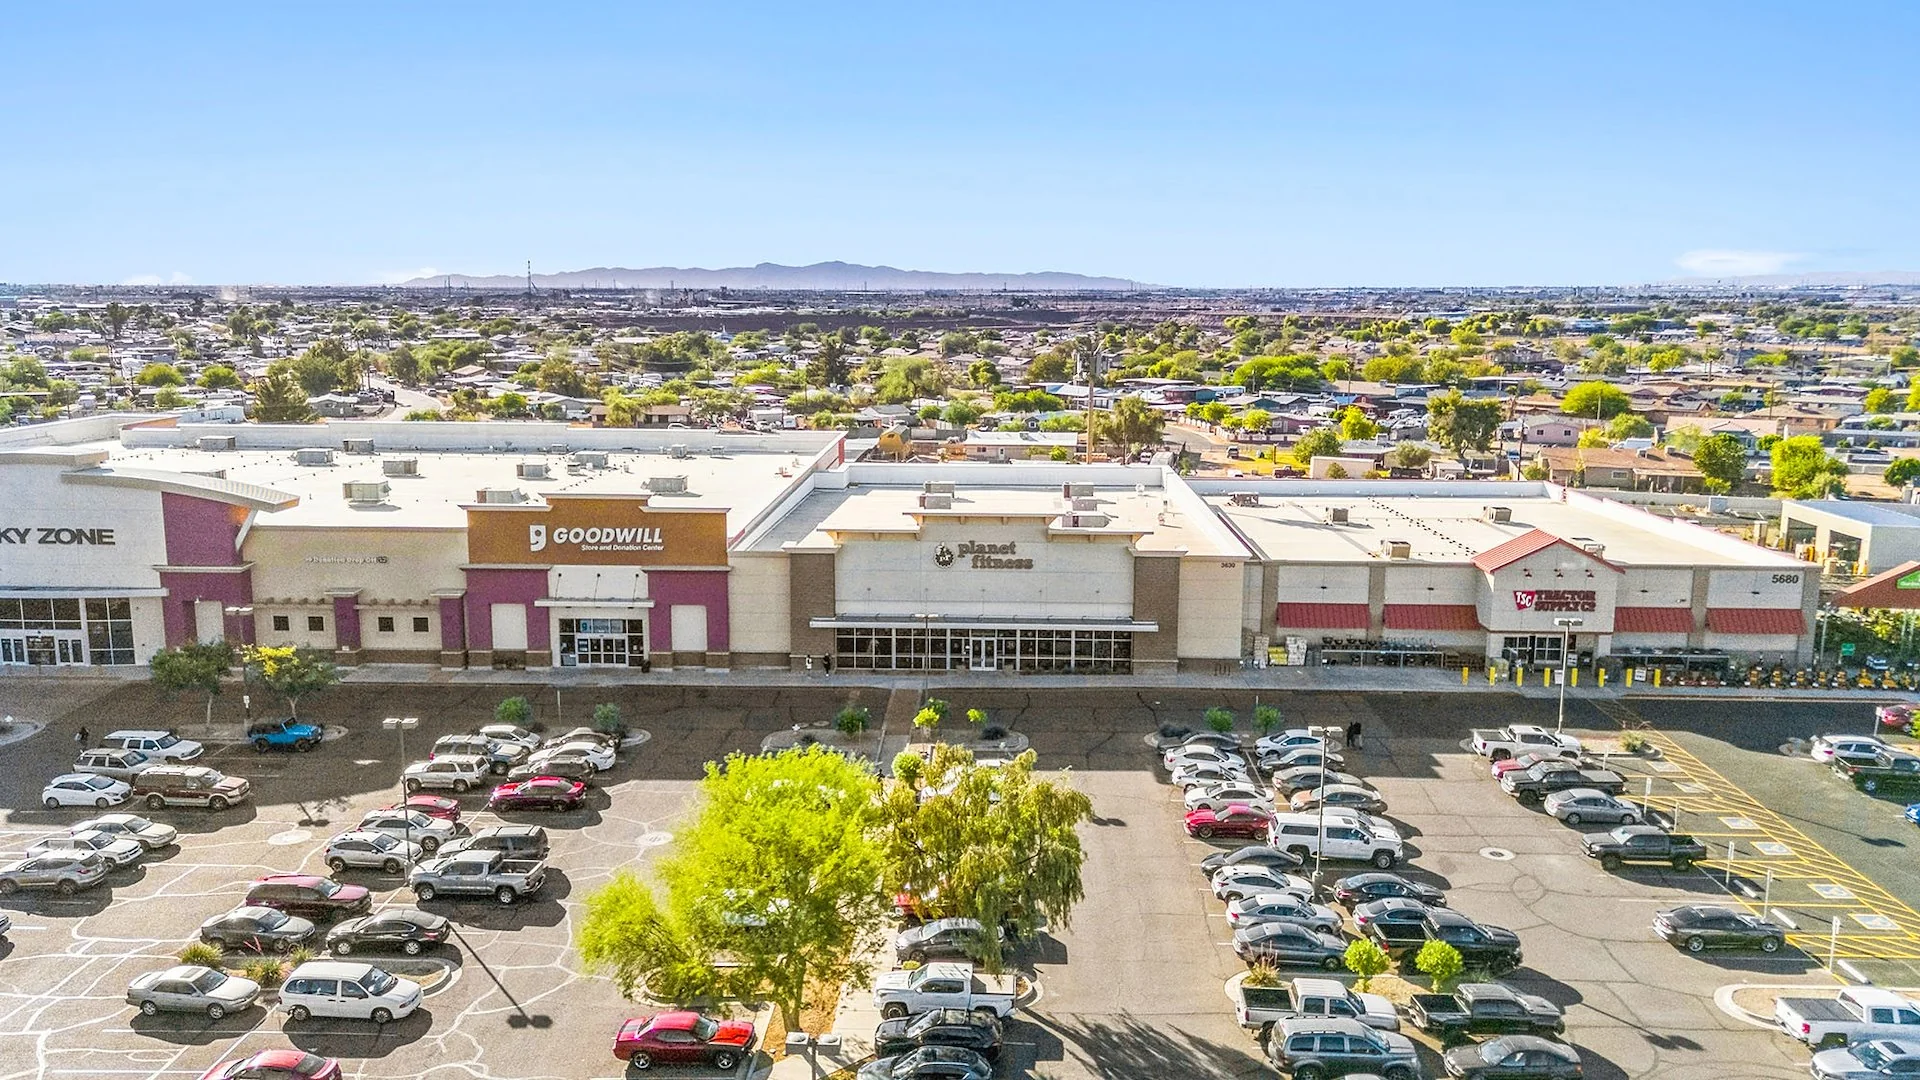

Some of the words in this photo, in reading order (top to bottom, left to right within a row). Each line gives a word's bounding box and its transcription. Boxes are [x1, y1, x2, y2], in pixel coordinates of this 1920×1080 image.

[0, 528, 32, 544] KY
[37, 528, 116, 545] ZONE
[552, 527, 663, 544] GOODWILL
[957, 540, 1016, 558] planet
[971, 555, 1033, 569] fitness
[1771, 574, 1799, 584] 5680
[1515, 591, 1532, 607] TSC
[1535, 590, 1596, 601] TRACTOR
[1534, 601, 1581, 612] SUPPLY
